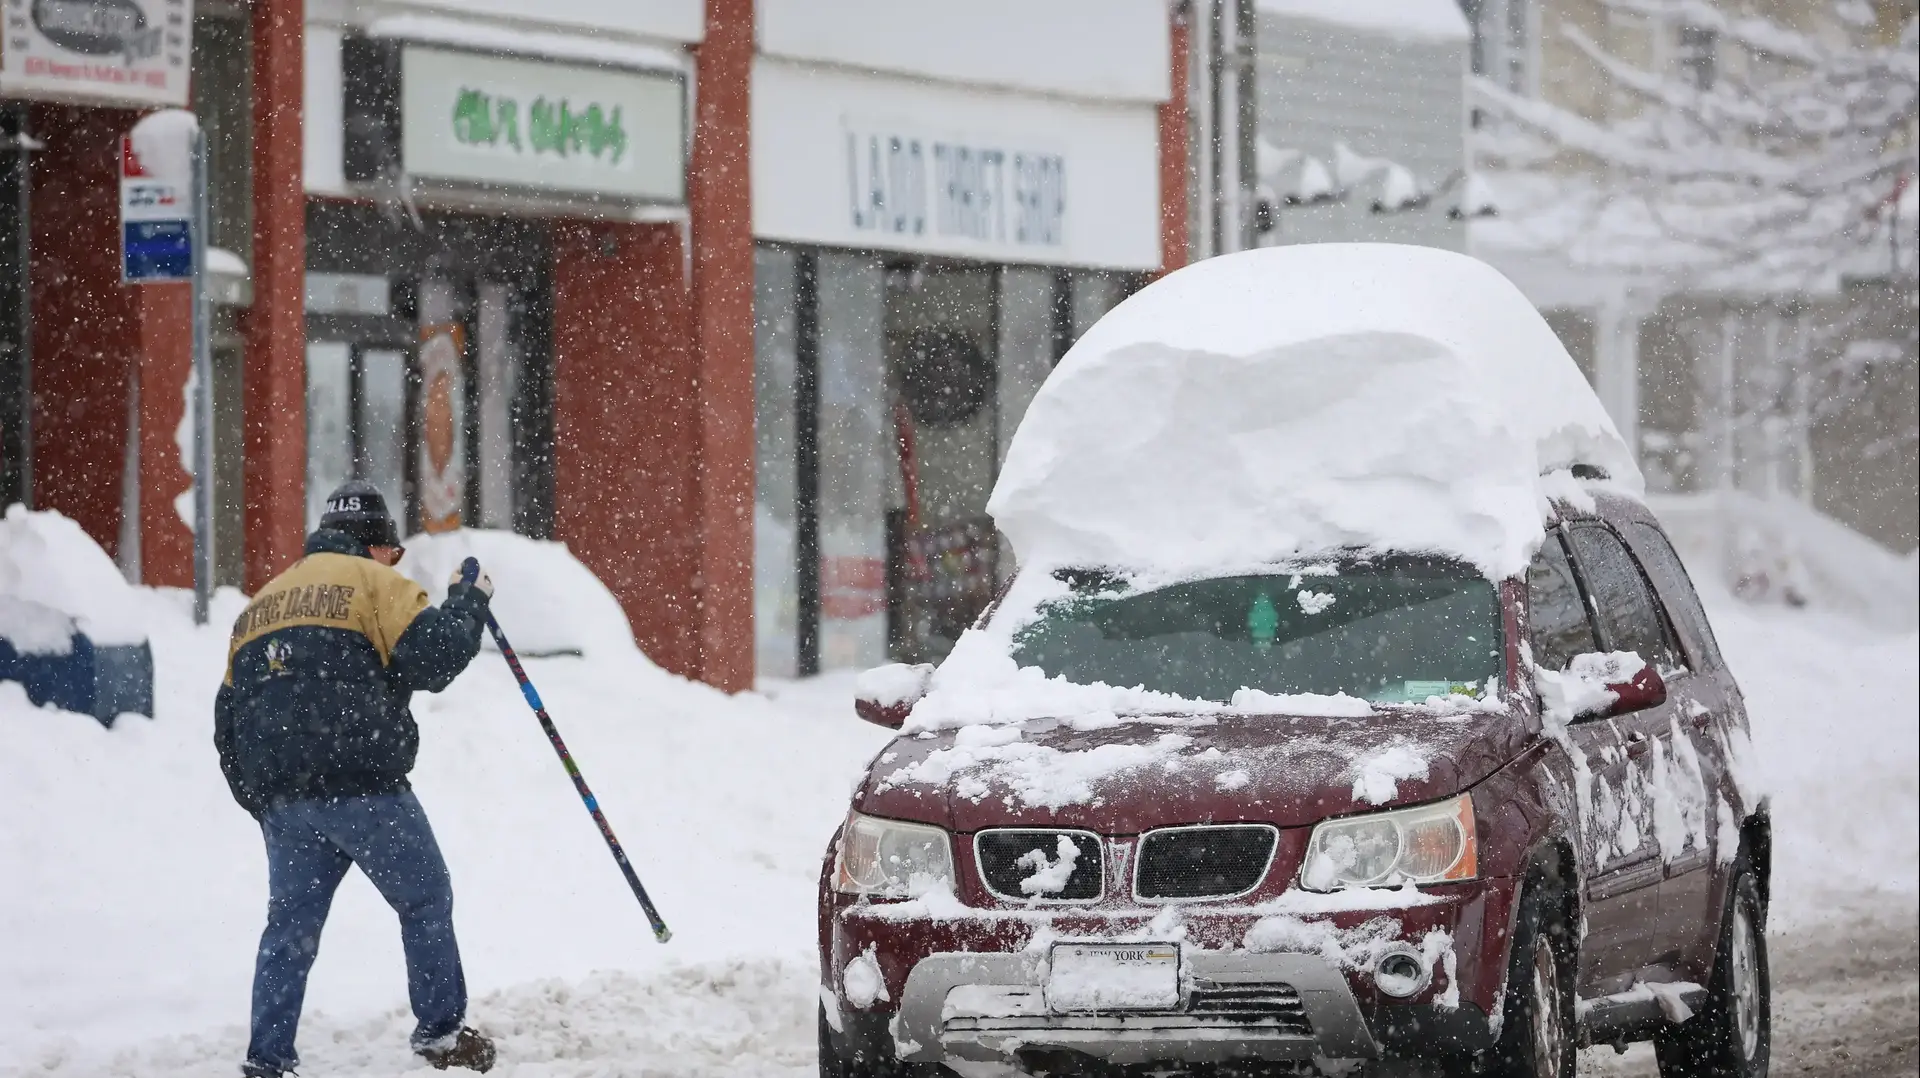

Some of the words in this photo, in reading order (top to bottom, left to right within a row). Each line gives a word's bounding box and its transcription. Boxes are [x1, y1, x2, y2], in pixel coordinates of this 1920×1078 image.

[848, 132, 926, 235] LADD
[933, 142, 1005, 241] THRIFT
[1012, 152, 1065, 245] SHOP
[283, 584, 354, 620] DAME
[1115, 951, 1145, 961] YORK
